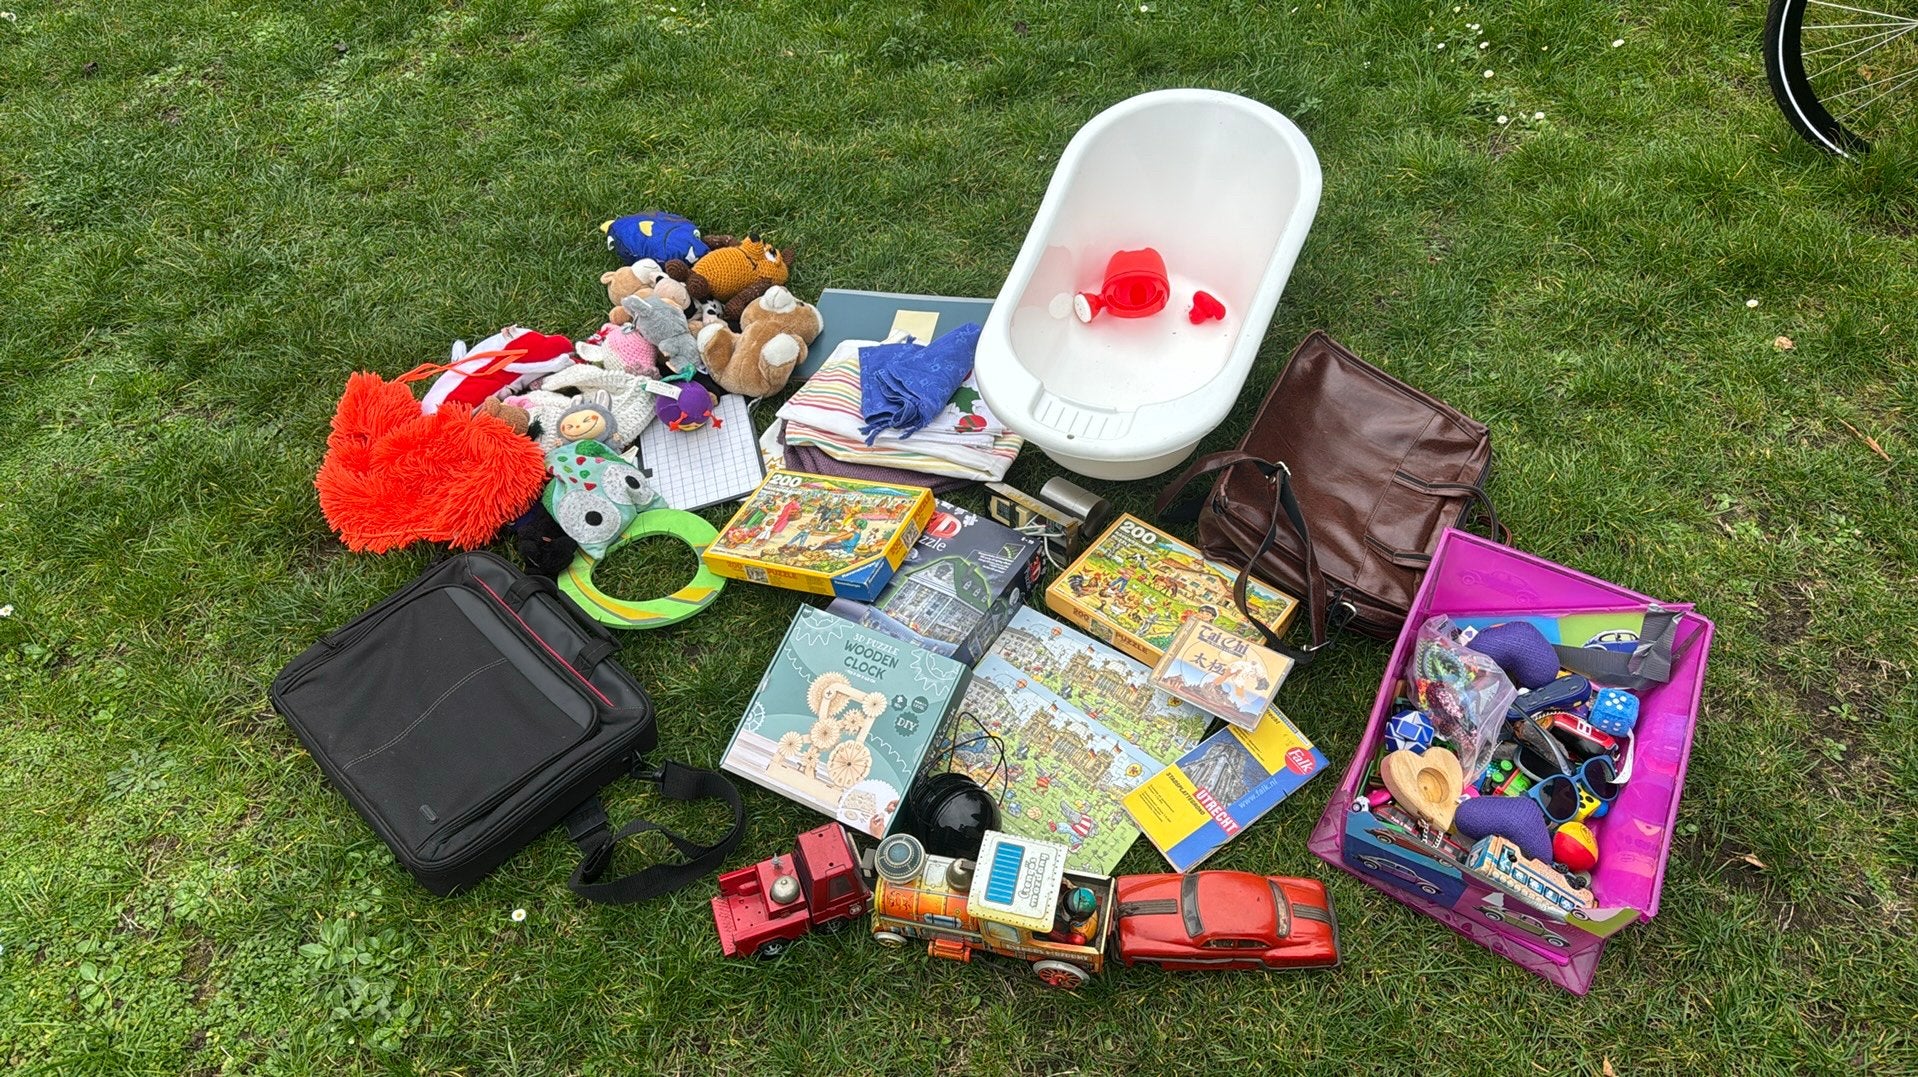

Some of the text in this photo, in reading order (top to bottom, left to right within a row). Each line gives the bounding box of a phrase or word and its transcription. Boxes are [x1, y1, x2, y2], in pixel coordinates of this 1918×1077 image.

[770, 474, 803, 488] 200
[919, 535, 947, 552] zzle
[1120, 521, 1157, 545] 200
[1073, 607, 1148, 655] 200 PUZZLE
[1198, 625, 1223, 644] Tai
[1220, 637, 1250, 655] Chi
[844, 640, 900, 669] WOODEN
[852, 633, 900, 656] 3D PUZZLE
[844, 656, 887, 680] CLOCK
[897, 717, 917, 731] DIY
[1288, 748, 1313, 773] Falk
[1166, 772, 1205, 816] STADSPLATTEGROND
[1240, 778, 1278, 809] www.falk.nl
[1195, 788, 1239, 832] UTRECHT
